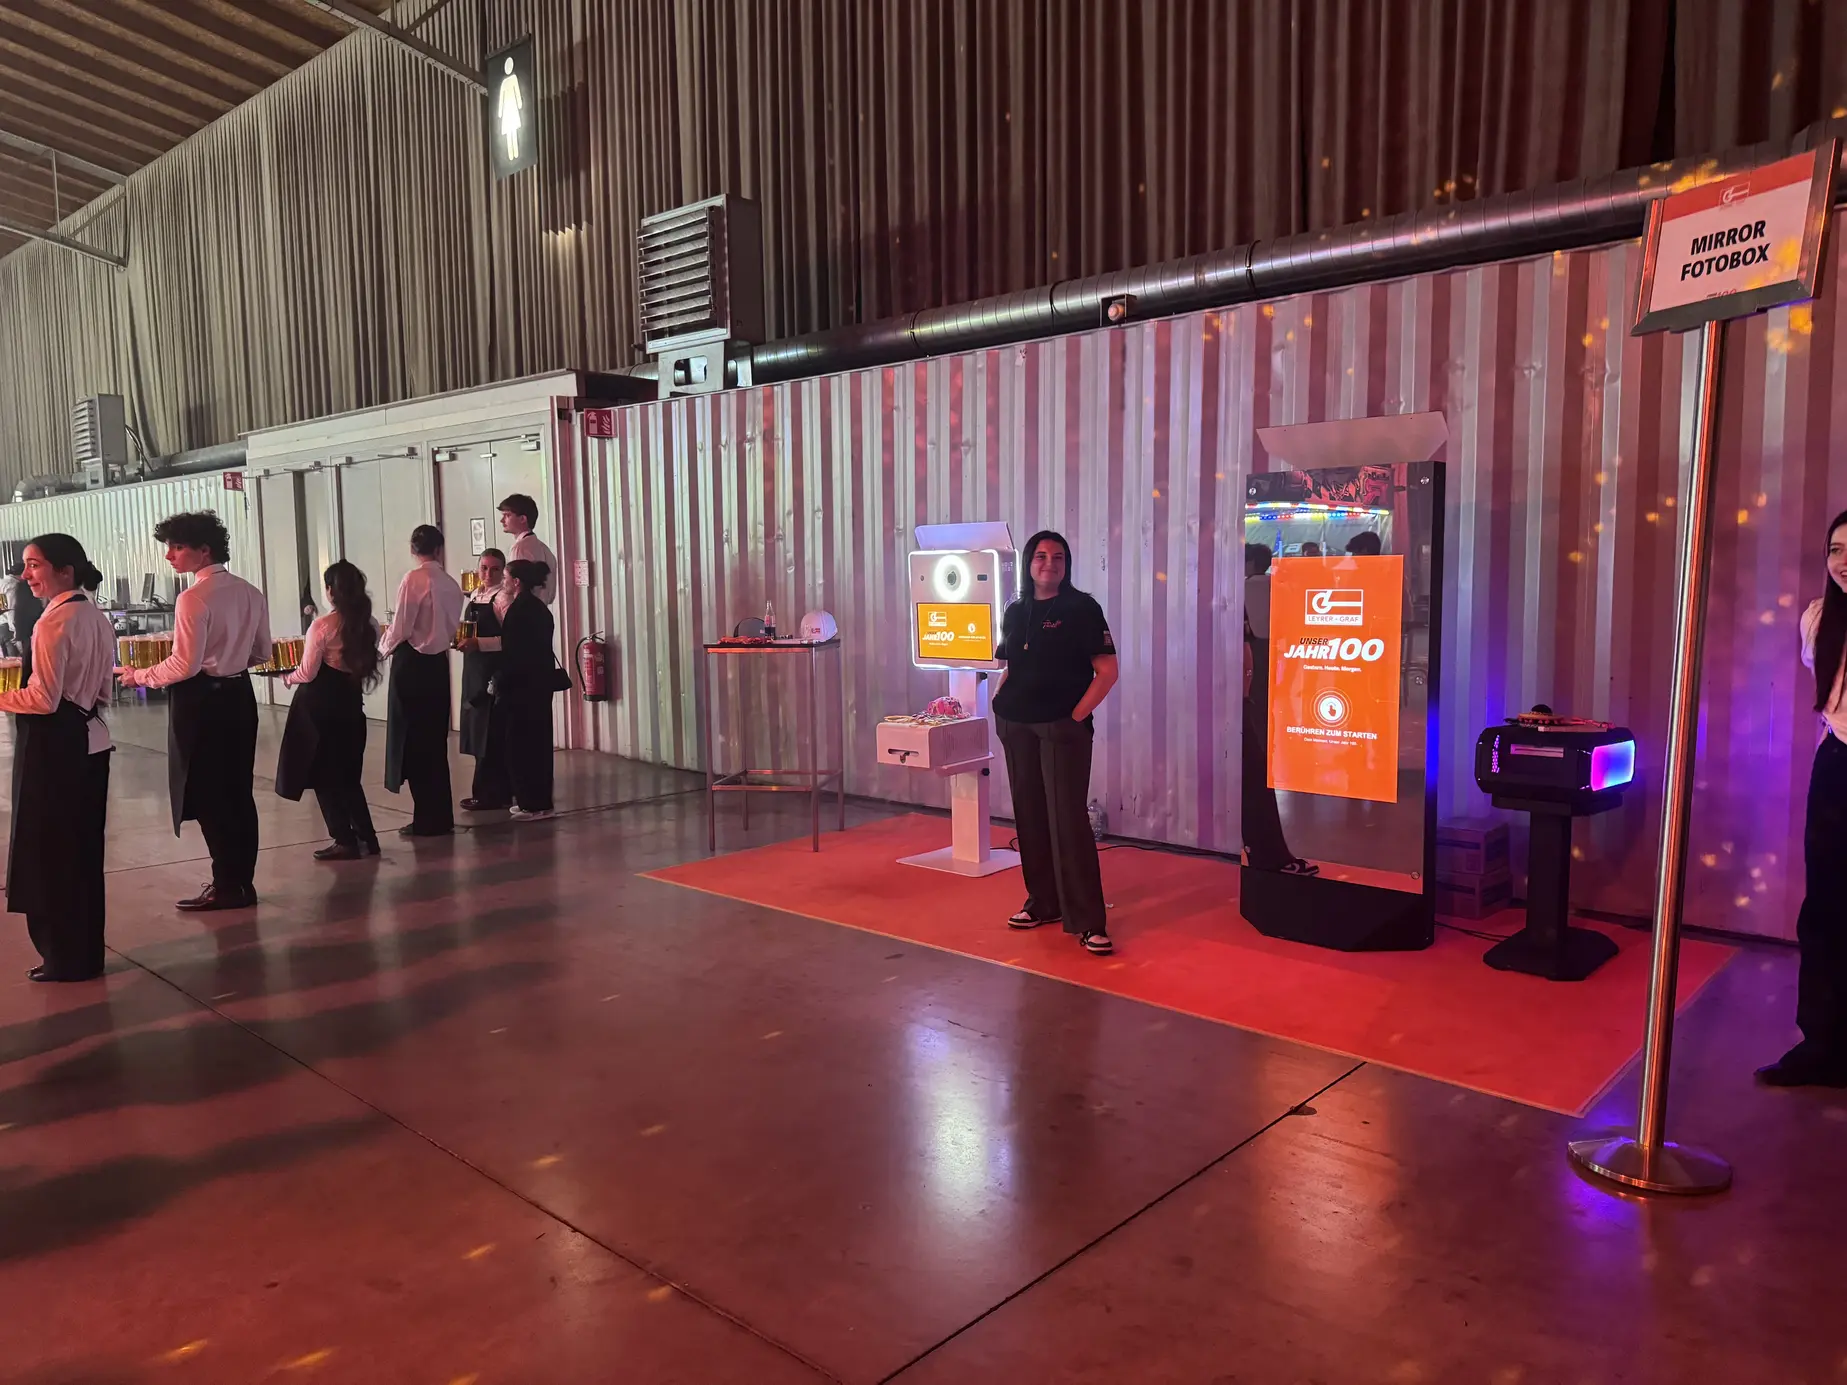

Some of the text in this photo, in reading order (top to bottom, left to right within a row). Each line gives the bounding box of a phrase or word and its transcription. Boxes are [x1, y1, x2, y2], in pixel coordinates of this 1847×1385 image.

[1690, 220, 1767, 256] MIRROR
[1680, 243, 1771, 282] FOTOBOX
[1299, 637, 1328, 645] UNSER
[1286, 726, 1378, 740] BERÜHREN ZUM STARTEN
